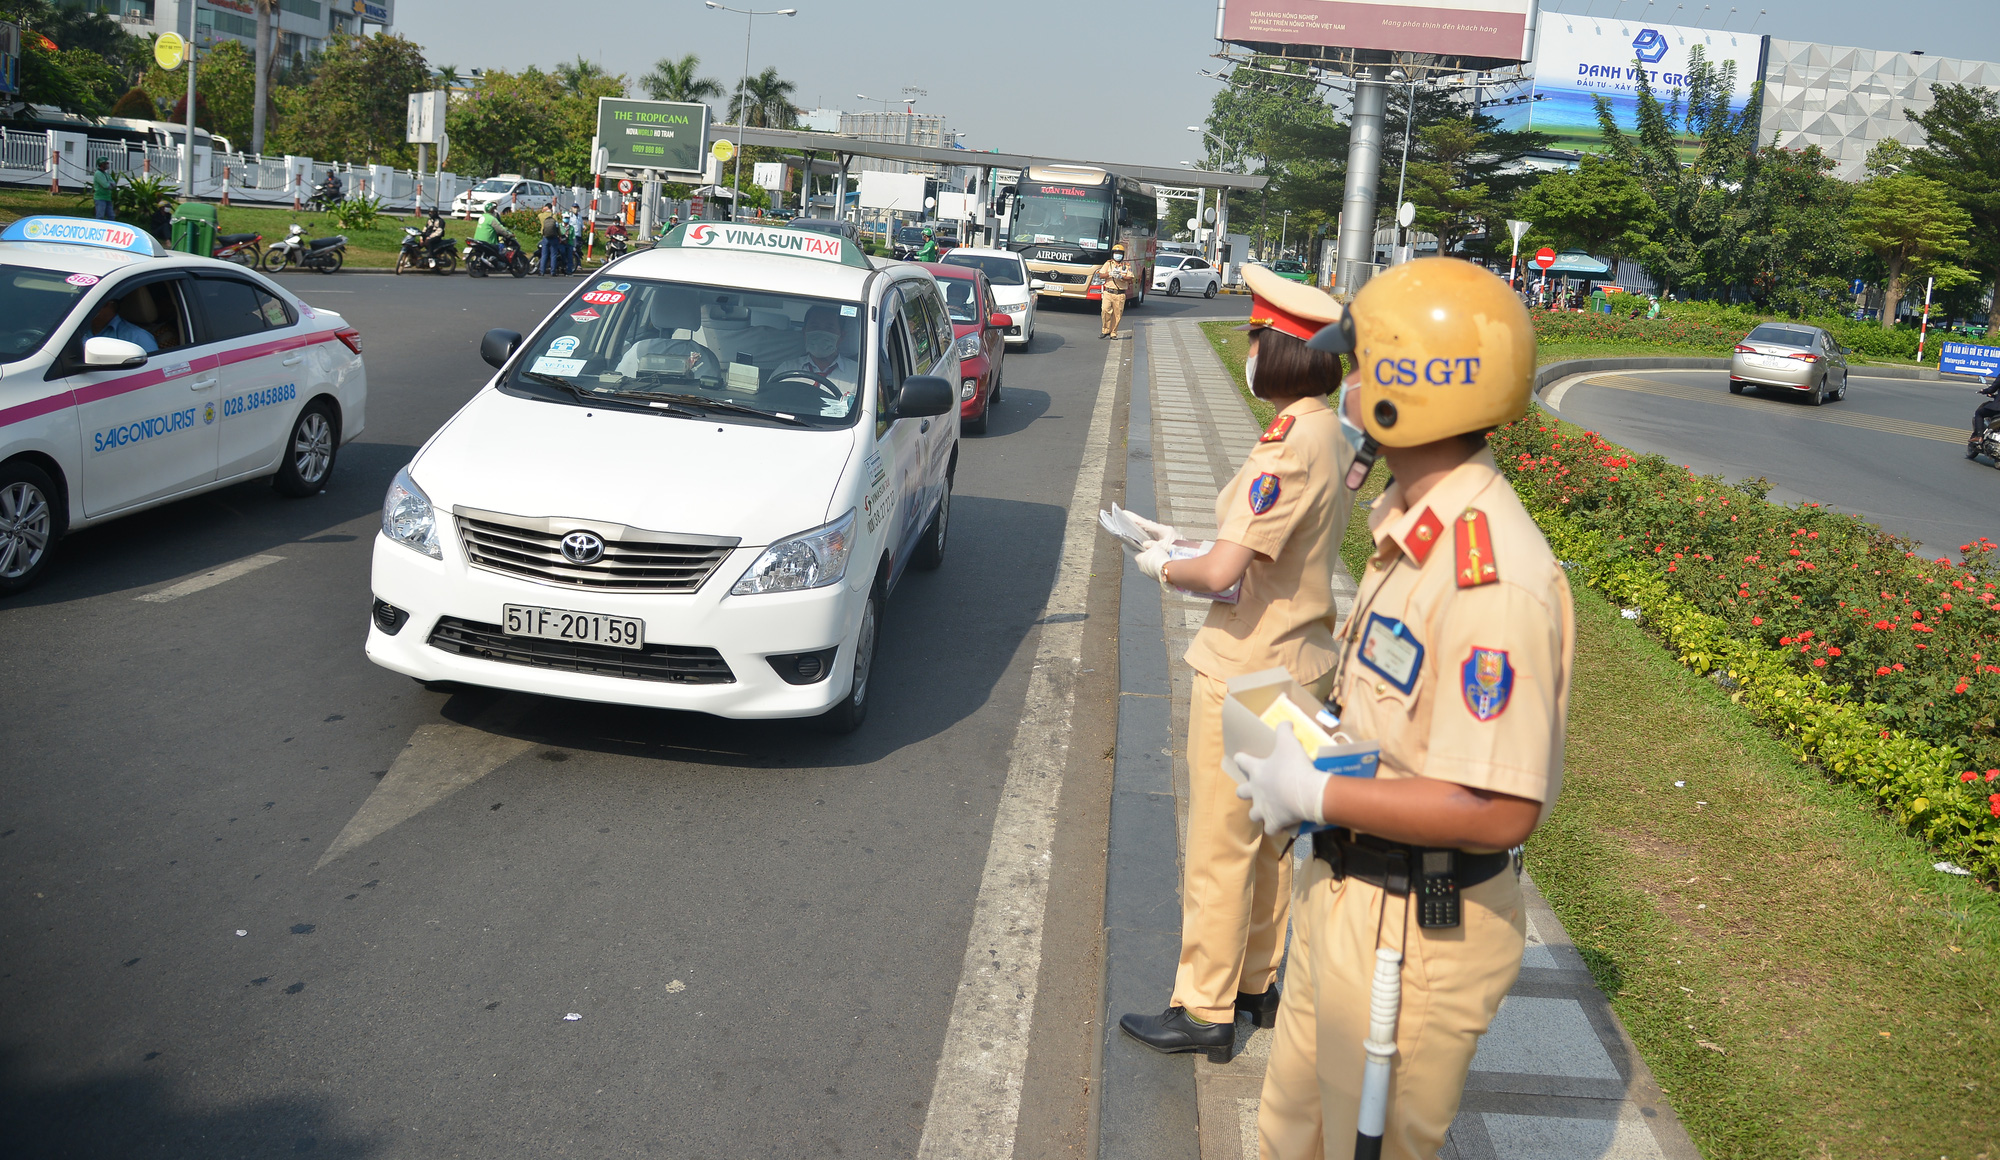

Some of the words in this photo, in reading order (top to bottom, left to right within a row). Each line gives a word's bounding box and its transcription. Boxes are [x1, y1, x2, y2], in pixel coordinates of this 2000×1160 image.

[1250, 10, 1265, 18] NGÂN
[1299, 13, 1318, 21] NGHIỆP
[1258, 18, 1272, 26] PHÁT
[1381, 19, 1401, 28] Mang
[1422, 21, 1440, 30] thịnh
[1457, 23, 1477, 32] khách
[1249, 25, 1299, 33] www.agribank.com.vn
[1578, 63, 1621, 79] DANH
[1626, 68, 1658, 82] VIT
[1576, 78, 1595, 88] ĐẦU
[1614, 83, 1631, 91] XÂY
[614, 111, 633, 121] THE
[635, 112, 689, 125] TROPICANA
[626, 128, 653, 137] NOVAWORLD
[653, 129, 660, 137] HO
[661, 130, 674, 138] TRAM
[632, 144, 644, 153] 0909
[1041, 186, 1060, 194] TOÀN
[43, 223, 106, 241] SAIGONTOURIST
[105, 229, 133, 246] TAXI
[726, 230, 803, 250] VINASUN
[804, 237, 840, 256] TAXI
[1035, 250, 1073, 261] AIRPORT
[69, 274, 95, 285] 365
[583, 292, 622, 303] 8189
[1944, 357, 1966, 365] Motorcycle
[94, 408, 196, 452] SAIGONTOURIST
[224, 383, 296, 417] 028.38458888
[508, 607, 637, 645] 51F-201.59
